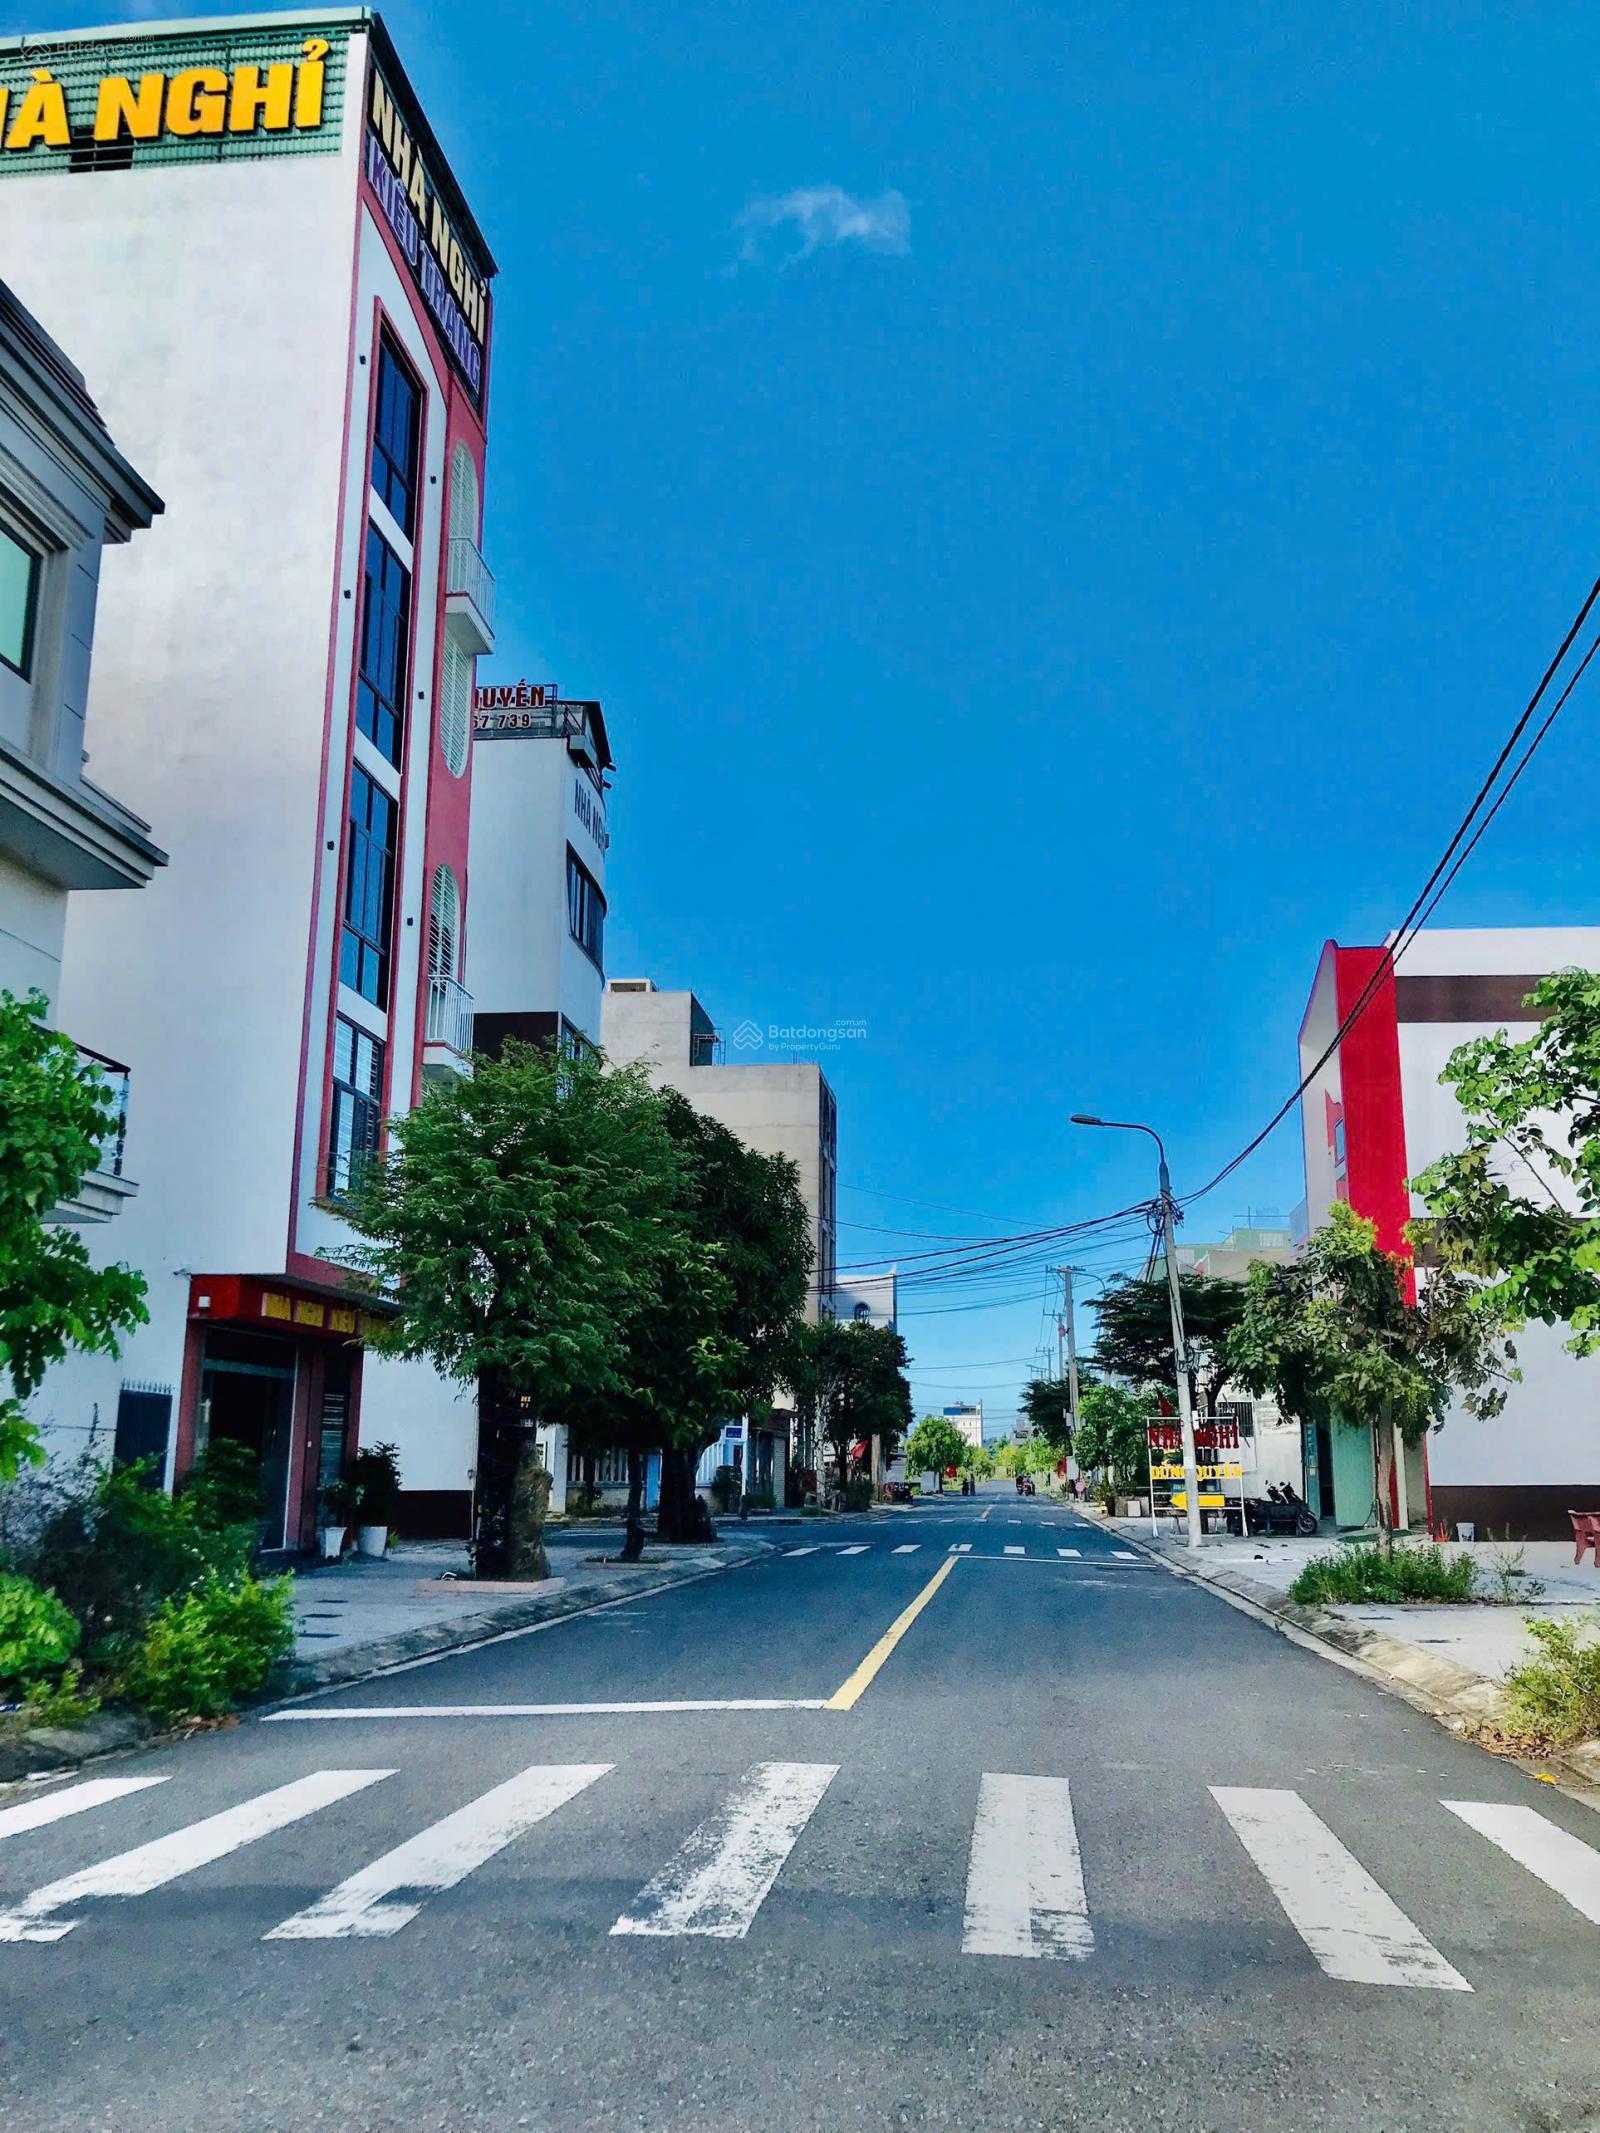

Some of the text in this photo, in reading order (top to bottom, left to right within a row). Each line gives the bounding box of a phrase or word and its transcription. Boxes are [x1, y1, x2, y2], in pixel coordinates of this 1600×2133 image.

[0, 38, 330, 149] À NGHỈ
[372, 68, 488, 346] NHÀ NGHỈ
[420, 239, 481, 395] TRANG
[498, 713, 530, 728] 739
[574, 778, 591, 835] NHÀ
